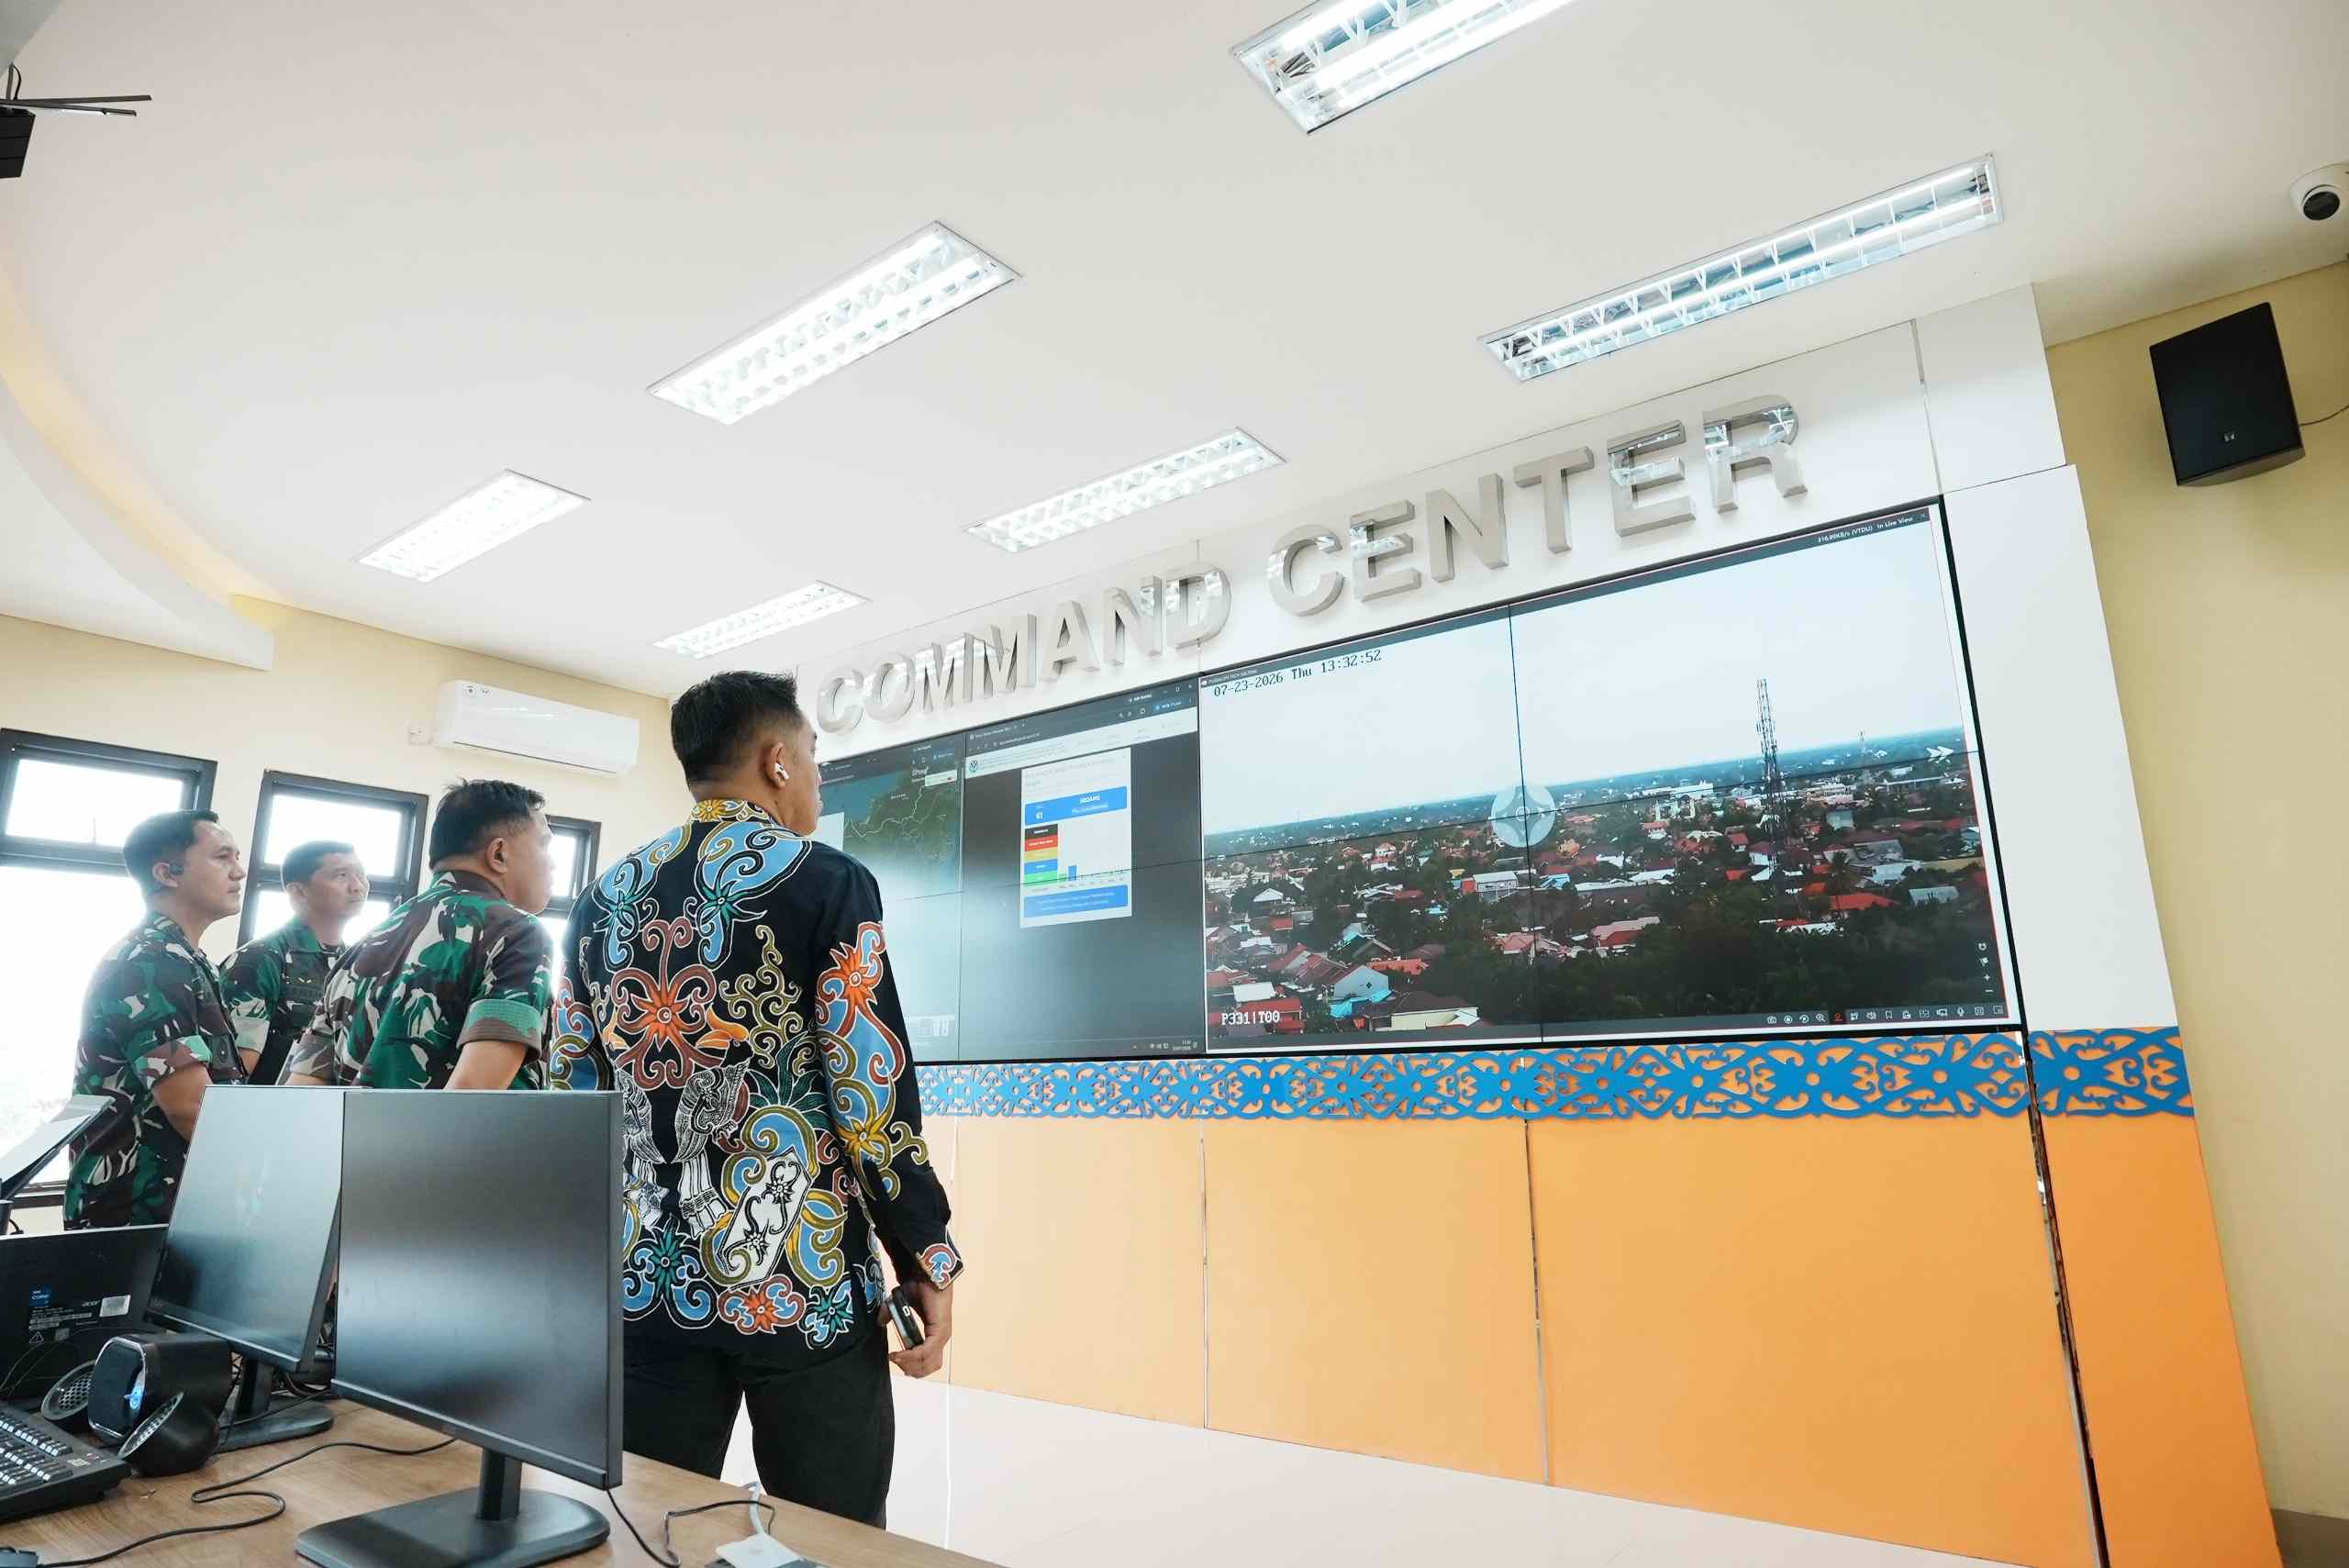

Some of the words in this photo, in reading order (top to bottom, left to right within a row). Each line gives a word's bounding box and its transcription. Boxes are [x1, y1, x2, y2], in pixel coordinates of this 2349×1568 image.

[1898, 516, 1914, 524] View
[818, 565, 1232, 733] COMMAND
[1268, 395, 1809, 615] CENTER
[1213, 673, 1284, 696] 07-23-2026
[1291, 667, 1312, 680] Thu
[1320, 650, 1382, 673] 13:32:52
